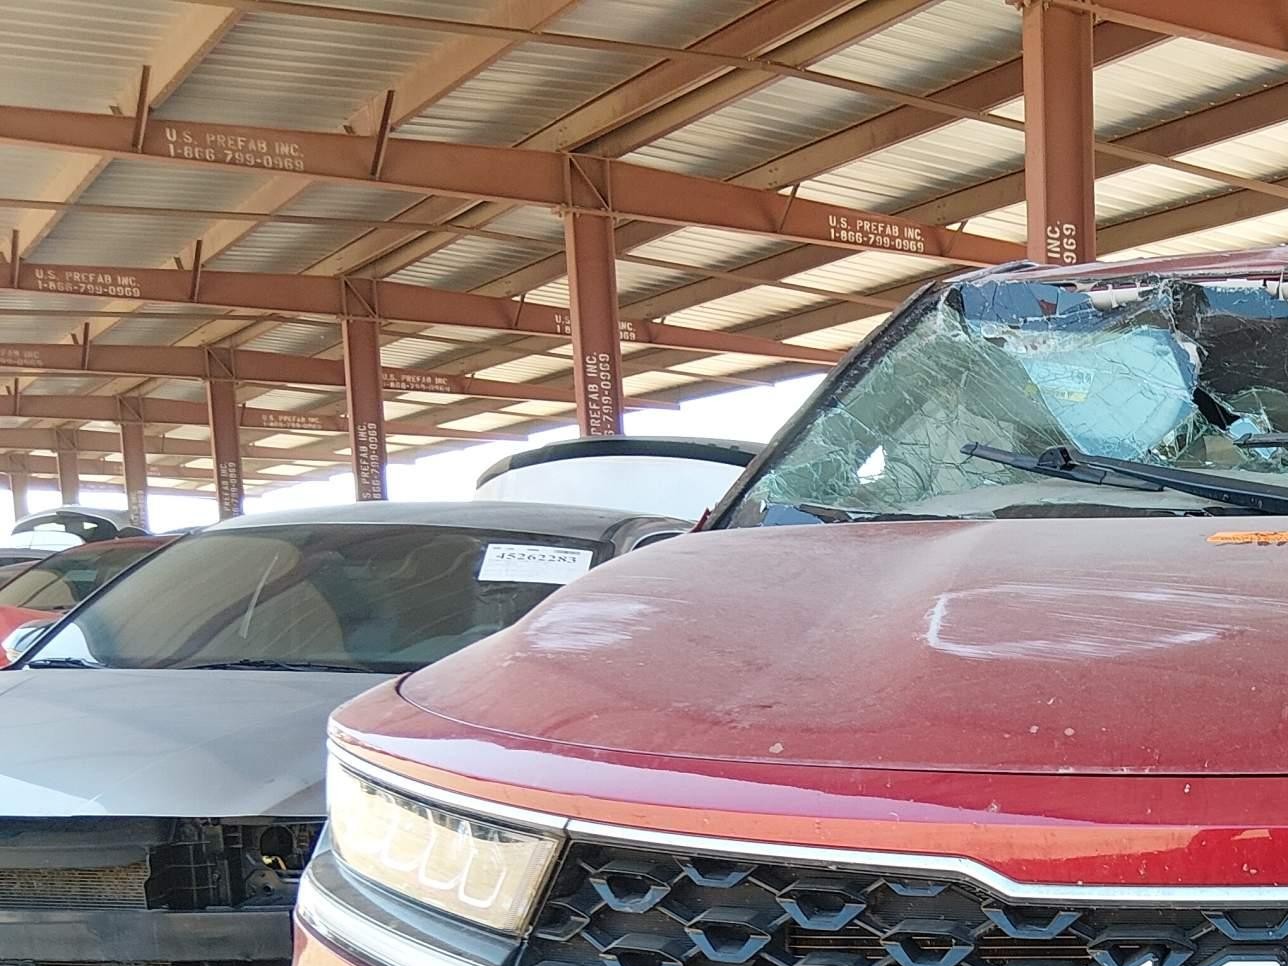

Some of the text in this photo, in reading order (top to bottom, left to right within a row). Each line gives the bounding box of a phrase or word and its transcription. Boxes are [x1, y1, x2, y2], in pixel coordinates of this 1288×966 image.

[165, 127, 304, 157] U.S. PREFAB INC.
[829, 215, 924, 241] U.S. PREFAB INC.
[830, 228, 924, 252] 1-866-799-0969
[1047, 220, 1060, 258] INC.
[65, 271, 112, 284] PREFAB
[586, 351, 598, 376] INC.
[496, 552, 577, 563] 45262283
